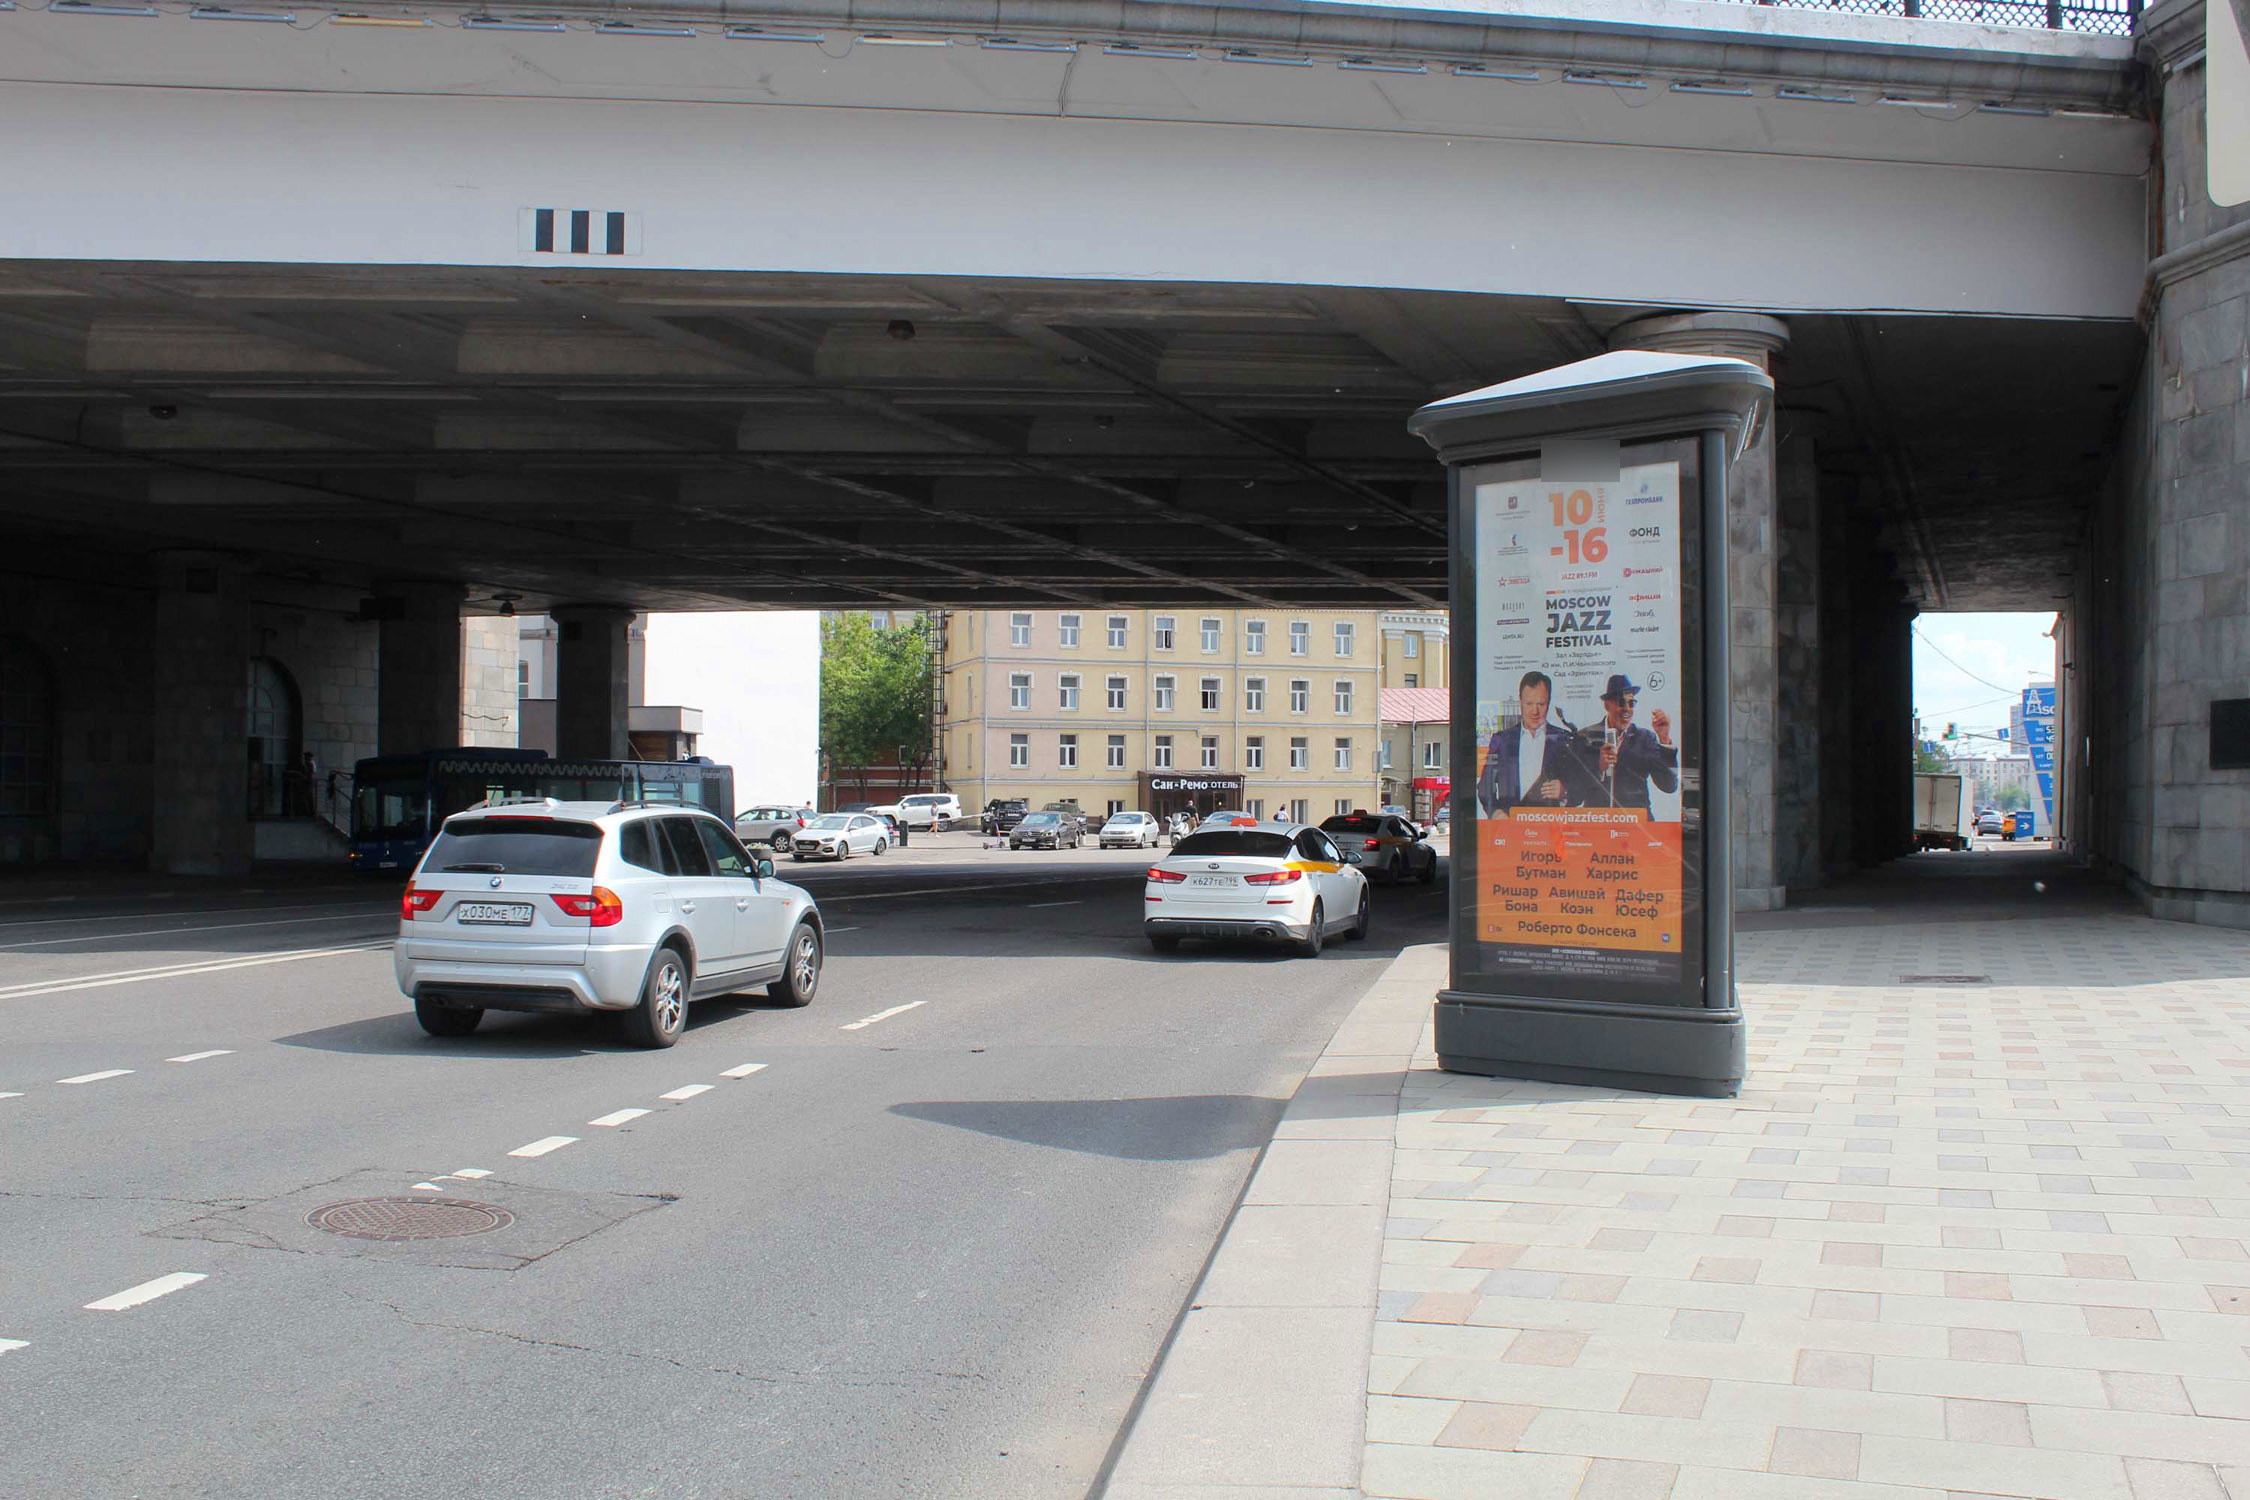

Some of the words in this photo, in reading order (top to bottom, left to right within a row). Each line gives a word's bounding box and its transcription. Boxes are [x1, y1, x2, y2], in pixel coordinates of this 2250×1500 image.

[1548, 489, 1594, 528] 10
[1629, 527, 1661, 537] ФОНД
[1550, 527, 1609, 565] -16
[1561, 572, 1575, 580] JAZZ
[1588, 571, 1598, 579] FM
[1545, 594, 1612, 611] MOSCOW
[1546, 610, 1612, 634] JAZZ
[1545, 634, 1612, 649] FESTIVAL
[1210, 781, 1239, 789] ОТЕЛЬ
[1516, 811, 1639, 824] moscowjazzfest.com
[1521, 851, 1562, 865] Игорь
[1590, 852, 1635, 865] Аллан
[1516, 866, 1567, 880] Бутман
[1586, 867, 1639, 881] Харрис
[1493, 884, 1538, 898] Ришар
[1549, 886, 1606, 900] Авишай
[1615, 889, 1664, 905] Дафер
[1505, 900, 1539, 913] Бона
[1560, 902, 1594, 915] Коэн
[1616, 904, 1659, 920] Юсеф
[1518, 921, 1574, 936] Роберто
[1576, 923, 1637, 938] Фонсека
